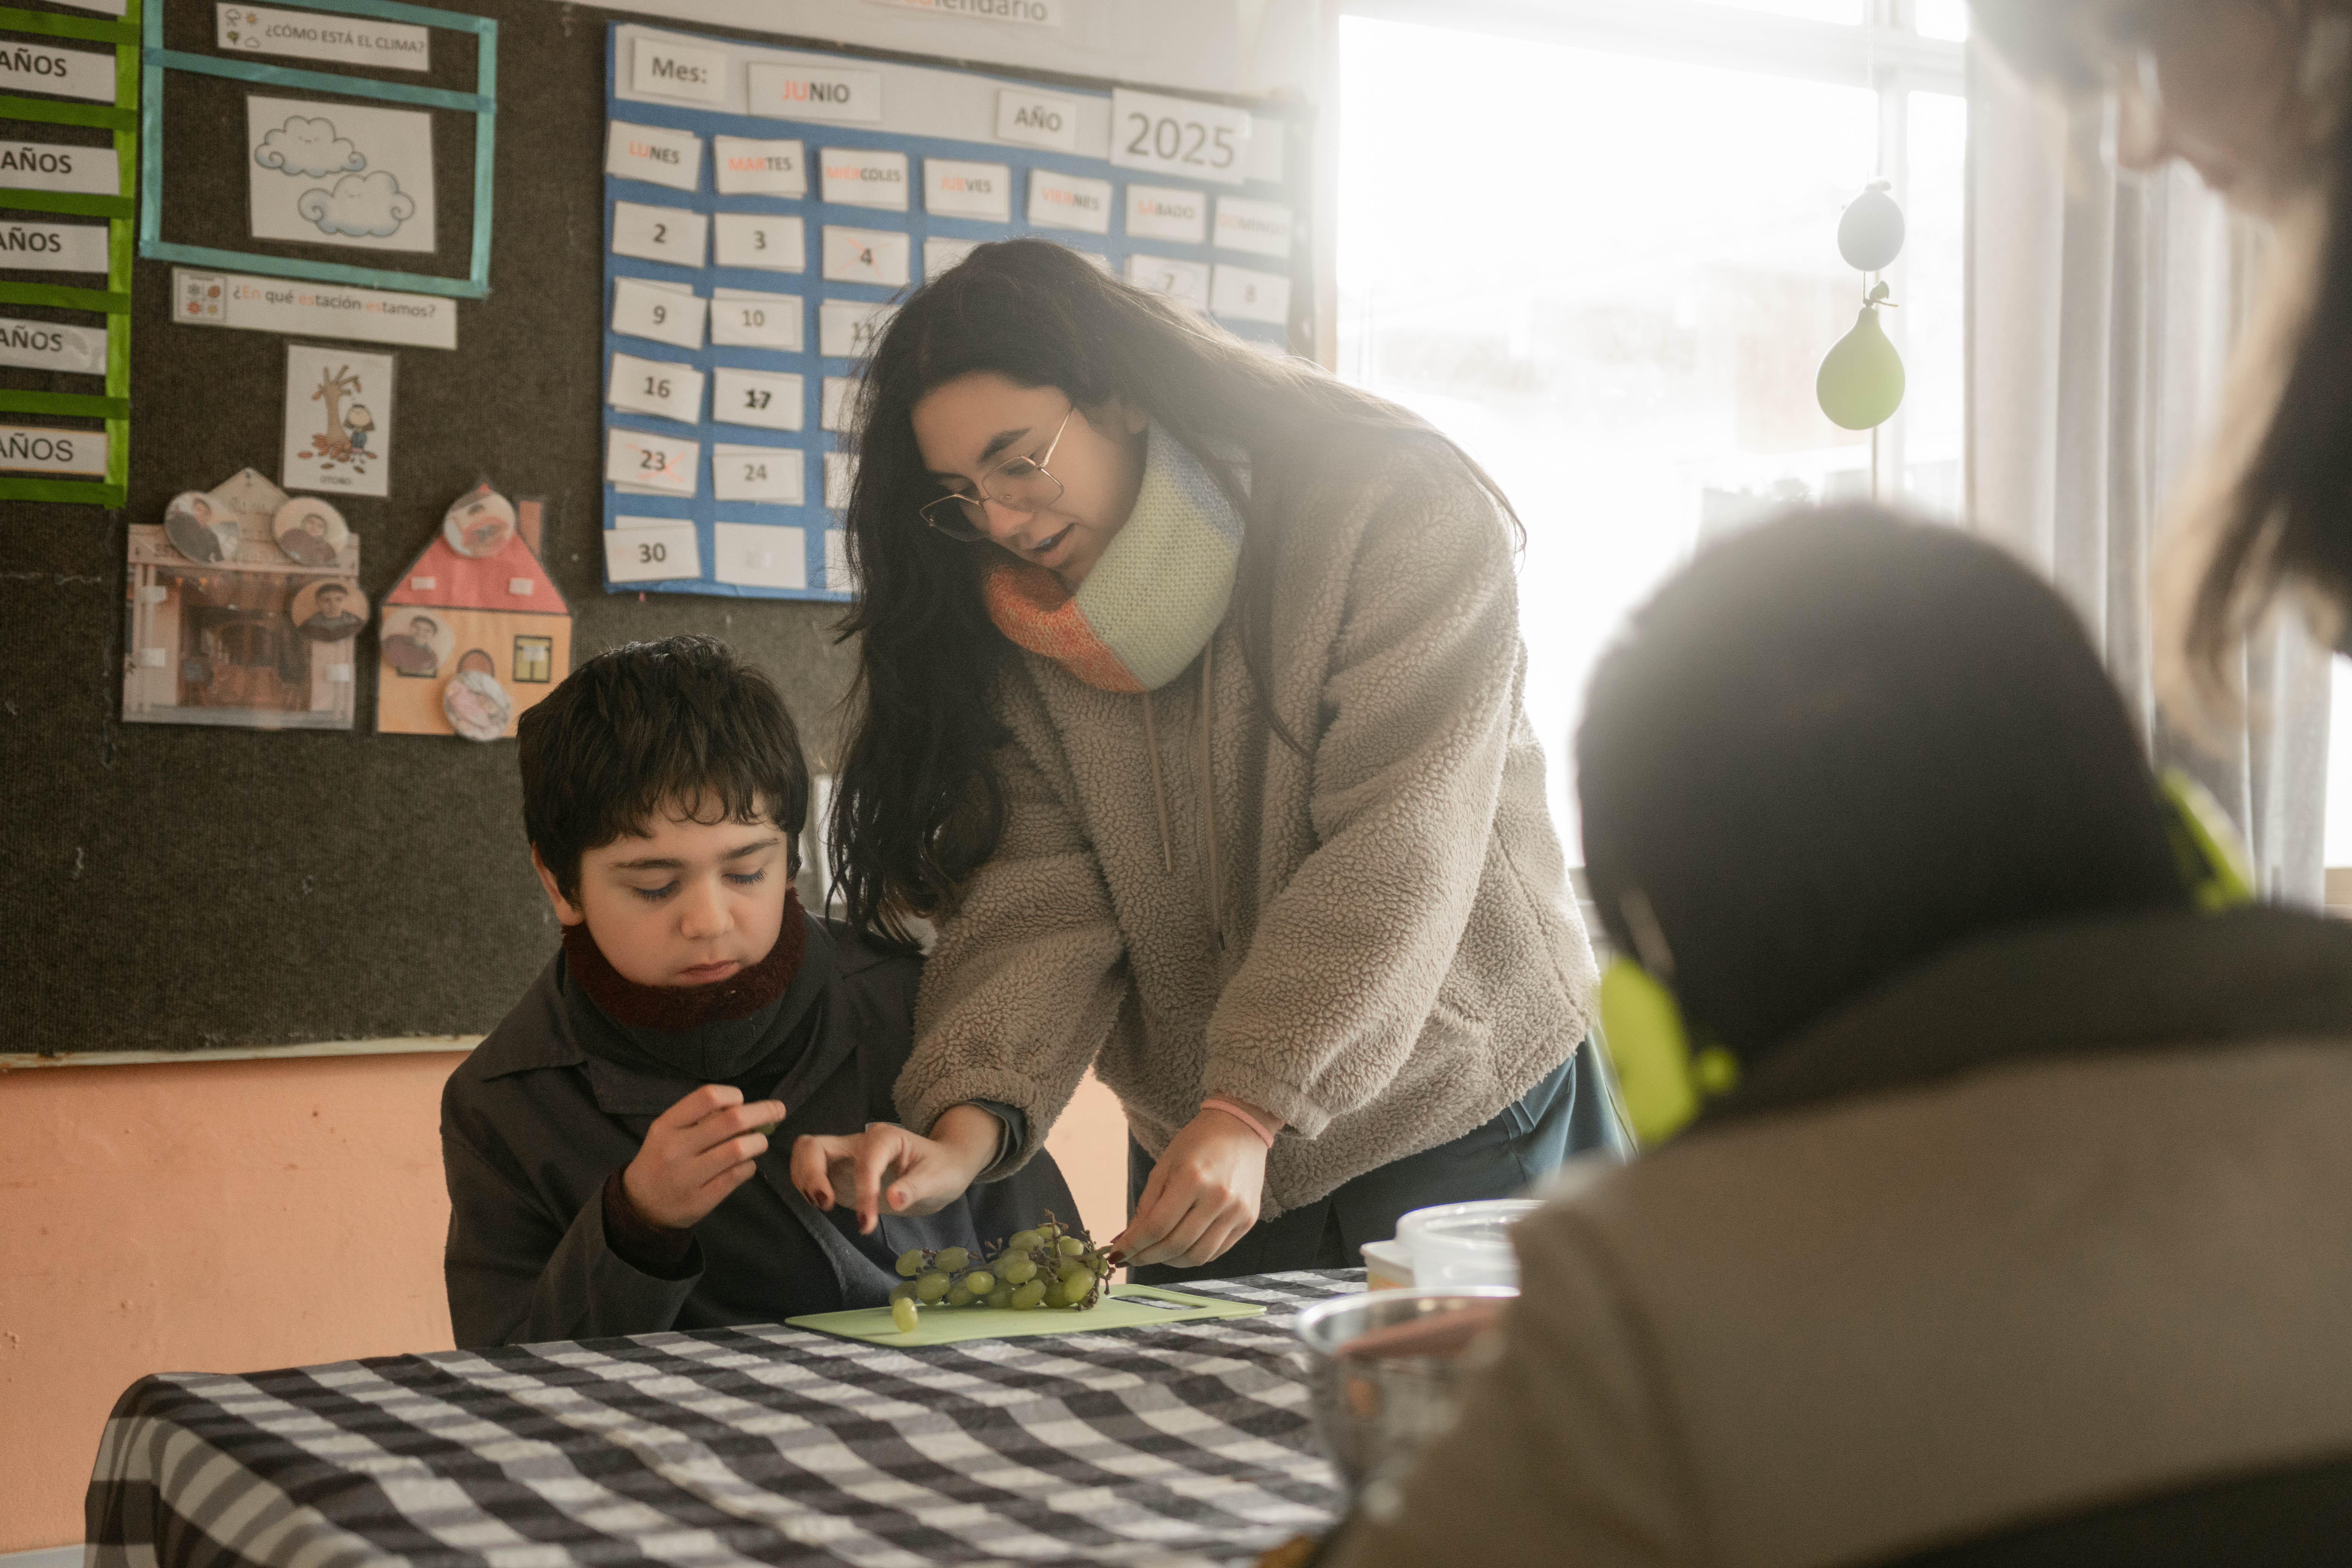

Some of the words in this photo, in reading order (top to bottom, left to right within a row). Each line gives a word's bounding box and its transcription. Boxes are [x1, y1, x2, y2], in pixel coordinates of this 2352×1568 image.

[906, 0, 1047, 21] endario
[266, 24, 318, 40] ¿CÓMO
[321, 30, 354, 44] ESTÁ
[357, 35, 373, 48] EL
[375, 37, 425, 53] CLIMA?
[0, 47, 67, 77] AÑOS
[652, 57, 707, 83] Mes:
[783, 81, 850, 104] JUNIO
[1013, 105, 1062, 132] AÑO
[1126, 112, 1235, 169] 2025
[0, 146, 72, 174] AÑOS
[629, 142, 680, 165] LUNES
[729, 156, 793, 172] MARTES
[940, 177, 993, 194] JUEVES
[1042, 188, 1100, 210] VIERNES
[1136, 199, 1195, 219] SÁBADO
[653, 224, 667, 244] 2
[754, 231, 767, 250] 3
[859, 248, 873, 266] 4
[233, 285, 261, 300] ¿En
[265, 290, 295, 304] qué
[298, 294, 362, 310] estación
[365, 301, 436, 318] estamos?
[653, 305, 667, 325] 9
[742, 310, 765, 327] 10
[852, 322, 874, 341] 11
[644, 376, 670, 399] 16
[744, 389, 771, 410] 17
[640, 449, 667, 472] 23
[744, 464, 767, 482] 24
[639, 543, 667, 564] 30
